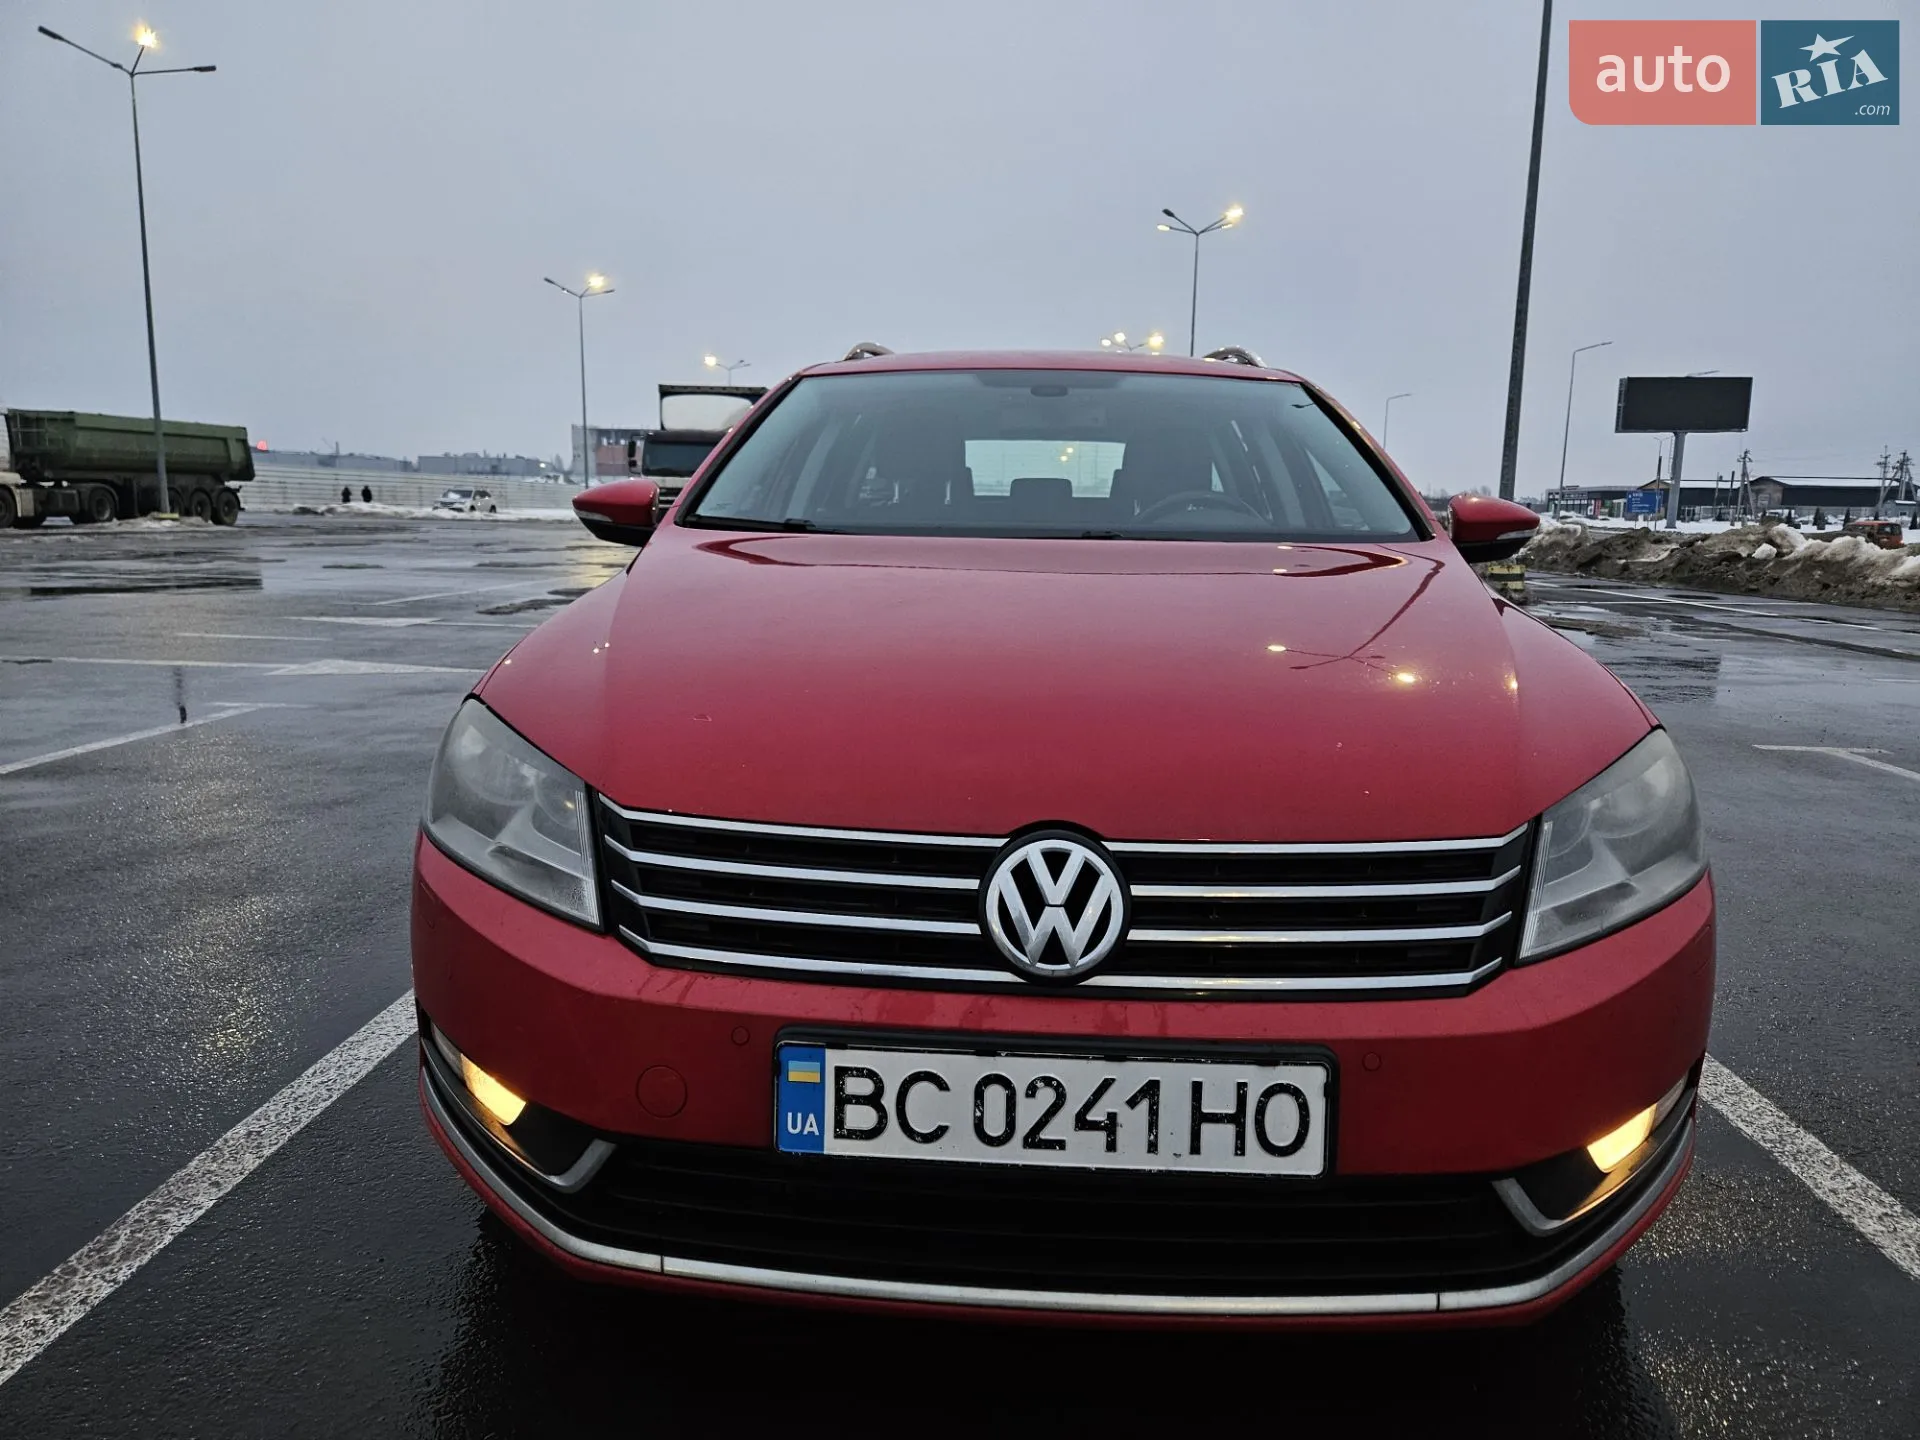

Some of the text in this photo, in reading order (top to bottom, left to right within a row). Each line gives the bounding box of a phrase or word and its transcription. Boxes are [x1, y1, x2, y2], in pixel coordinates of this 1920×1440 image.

[786, 1111, 820, 1137] UA
[833, 1065, 1312, 1158] BC 0241 HO
